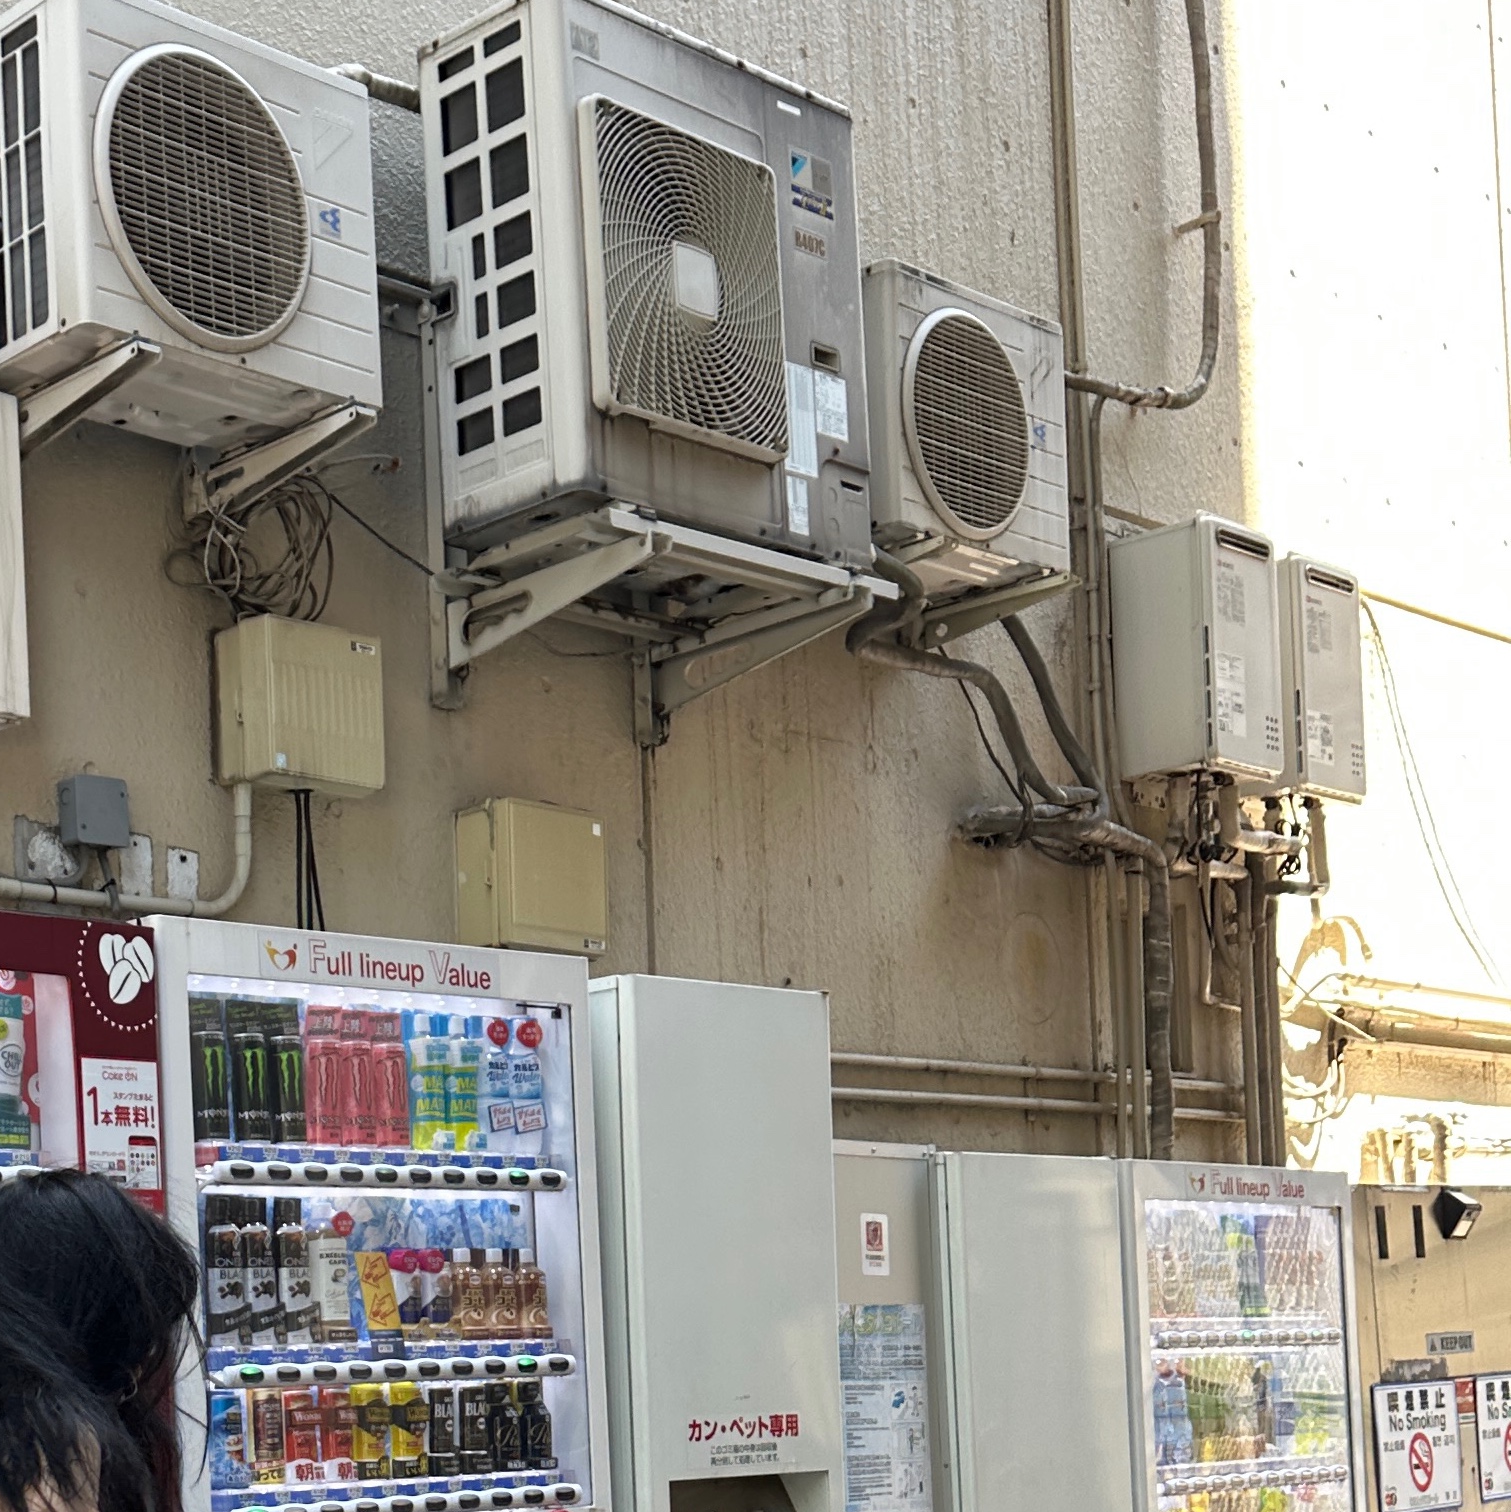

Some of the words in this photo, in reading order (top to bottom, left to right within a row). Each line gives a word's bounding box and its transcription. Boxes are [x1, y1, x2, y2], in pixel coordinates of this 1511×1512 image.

[307, 938, 353, 977] Full
[359, 956, 425, 988] lineup
[428, 949, 492, 990] Value
[1210, 1169, 1234, 1196] Full
[1236, 1178, 1270, 1200] lineup
[688, 1413, 800, 1443] カン・ペット専用
[1389, 1414, 1404, 1432] No
[1405, 1410, 1447, 1433] Smoking
[295, 1463, 314, 1482] 朝
